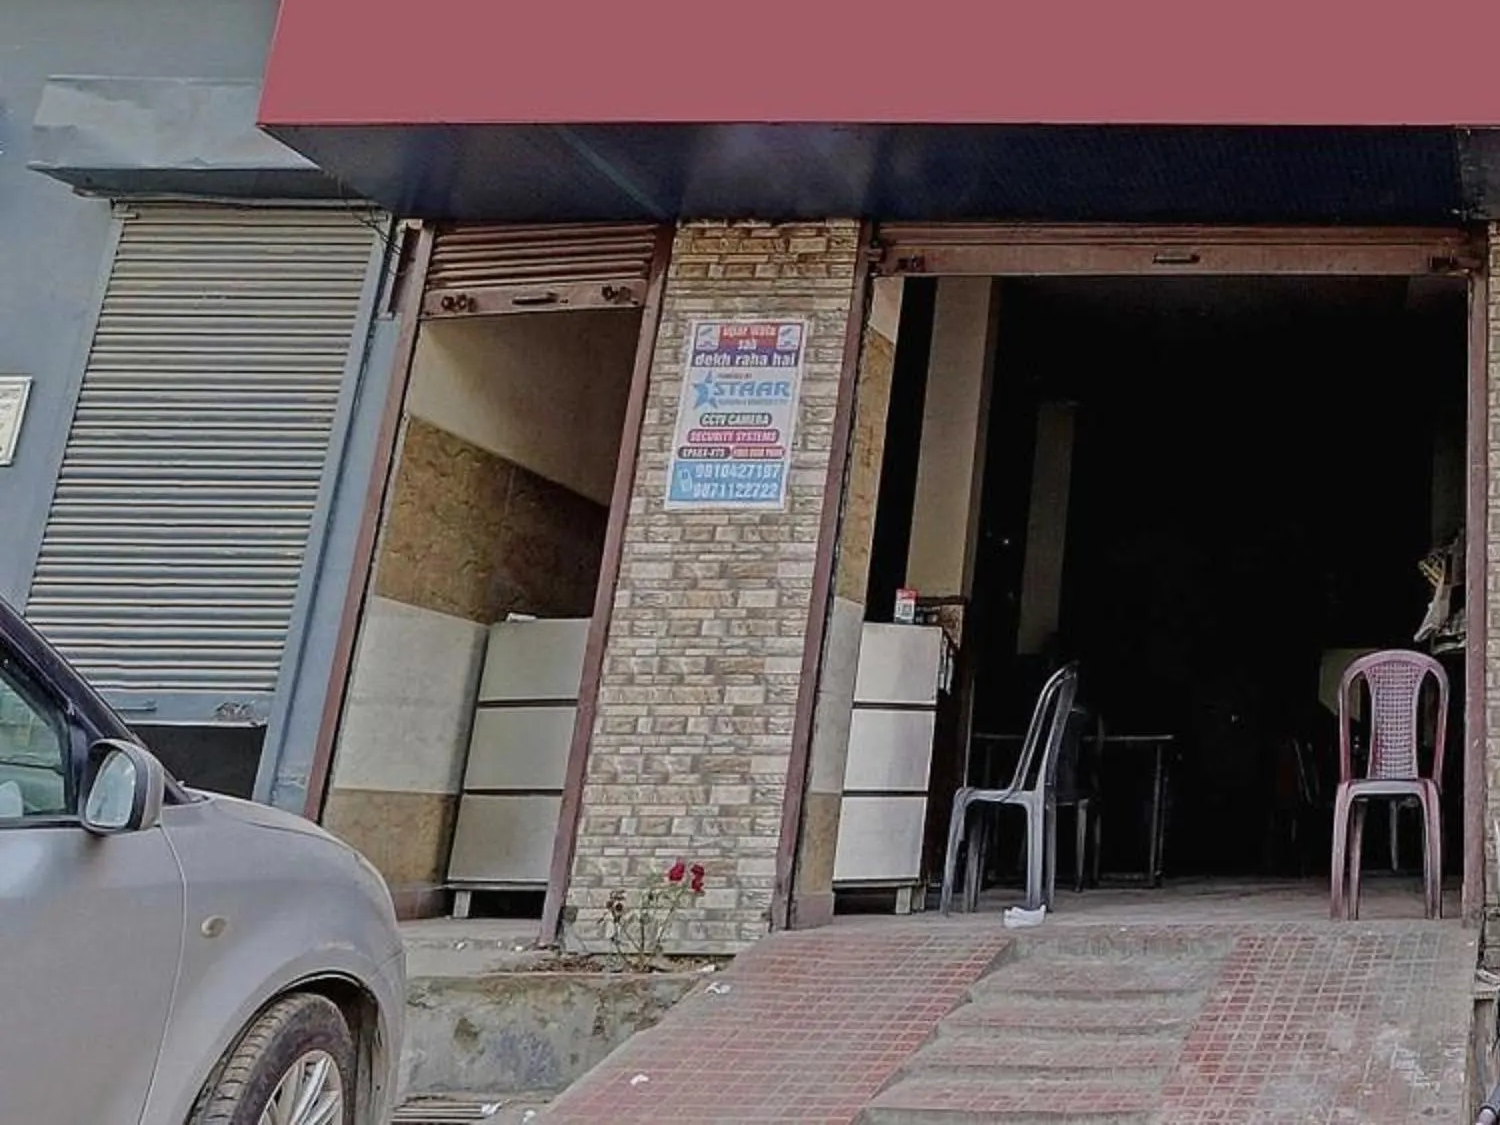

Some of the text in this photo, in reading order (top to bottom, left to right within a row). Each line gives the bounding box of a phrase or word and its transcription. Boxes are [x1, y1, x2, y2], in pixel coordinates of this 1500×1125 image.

[694, 352, 796, 366] dekh raha hai
[713, 381, 791, 397] STAAR
